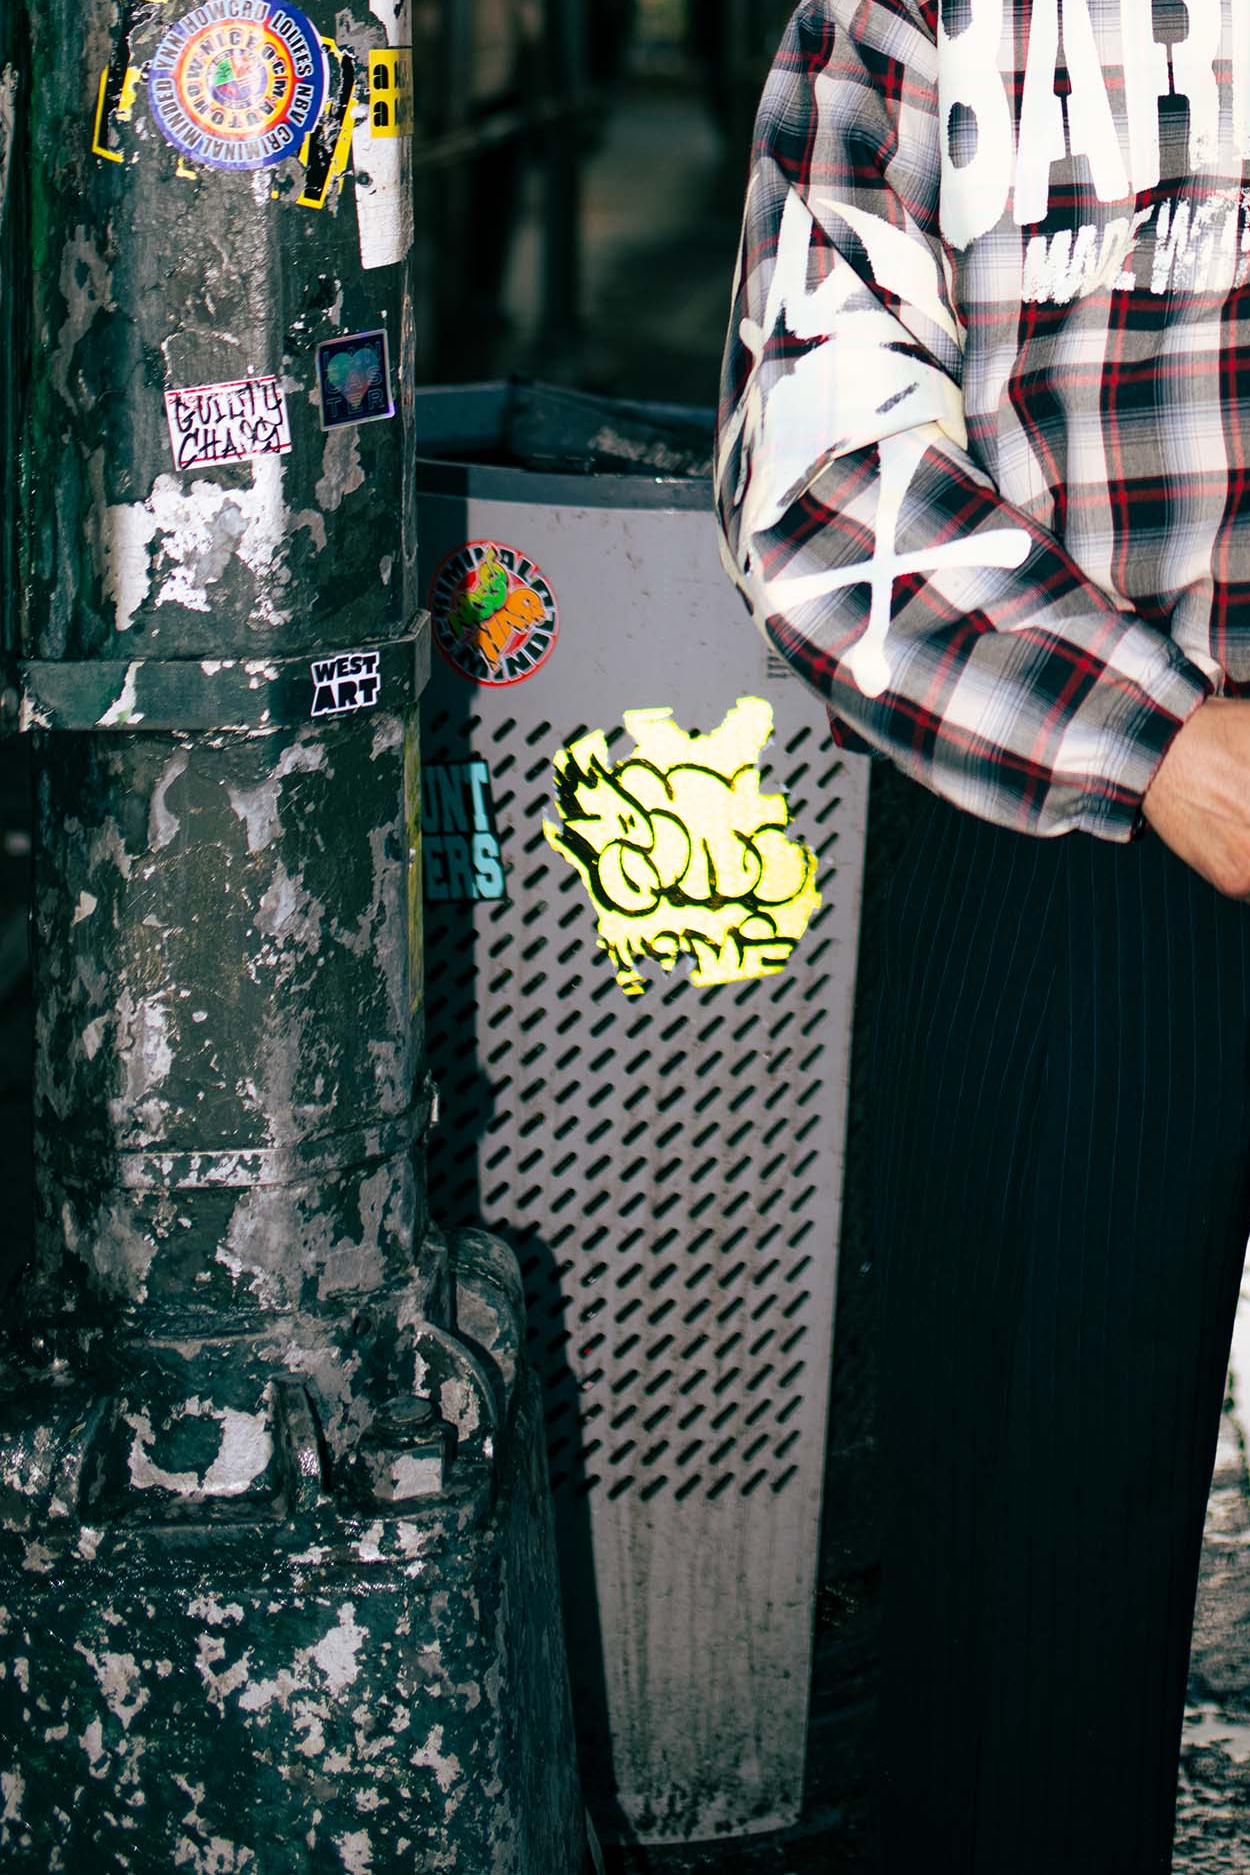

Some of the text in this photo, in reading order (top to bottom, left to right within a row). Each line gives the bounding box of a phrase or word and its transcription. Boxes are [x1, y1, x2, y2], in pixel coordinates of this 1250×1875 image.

[155, 78, 201, 148] MINDED
[202, 125, 292, 161] CRIMINAL
[1021, 205, 1153, 304] MADE
[314, 654, 378, 685] WEST
[313, 677, 379, 713] ART
